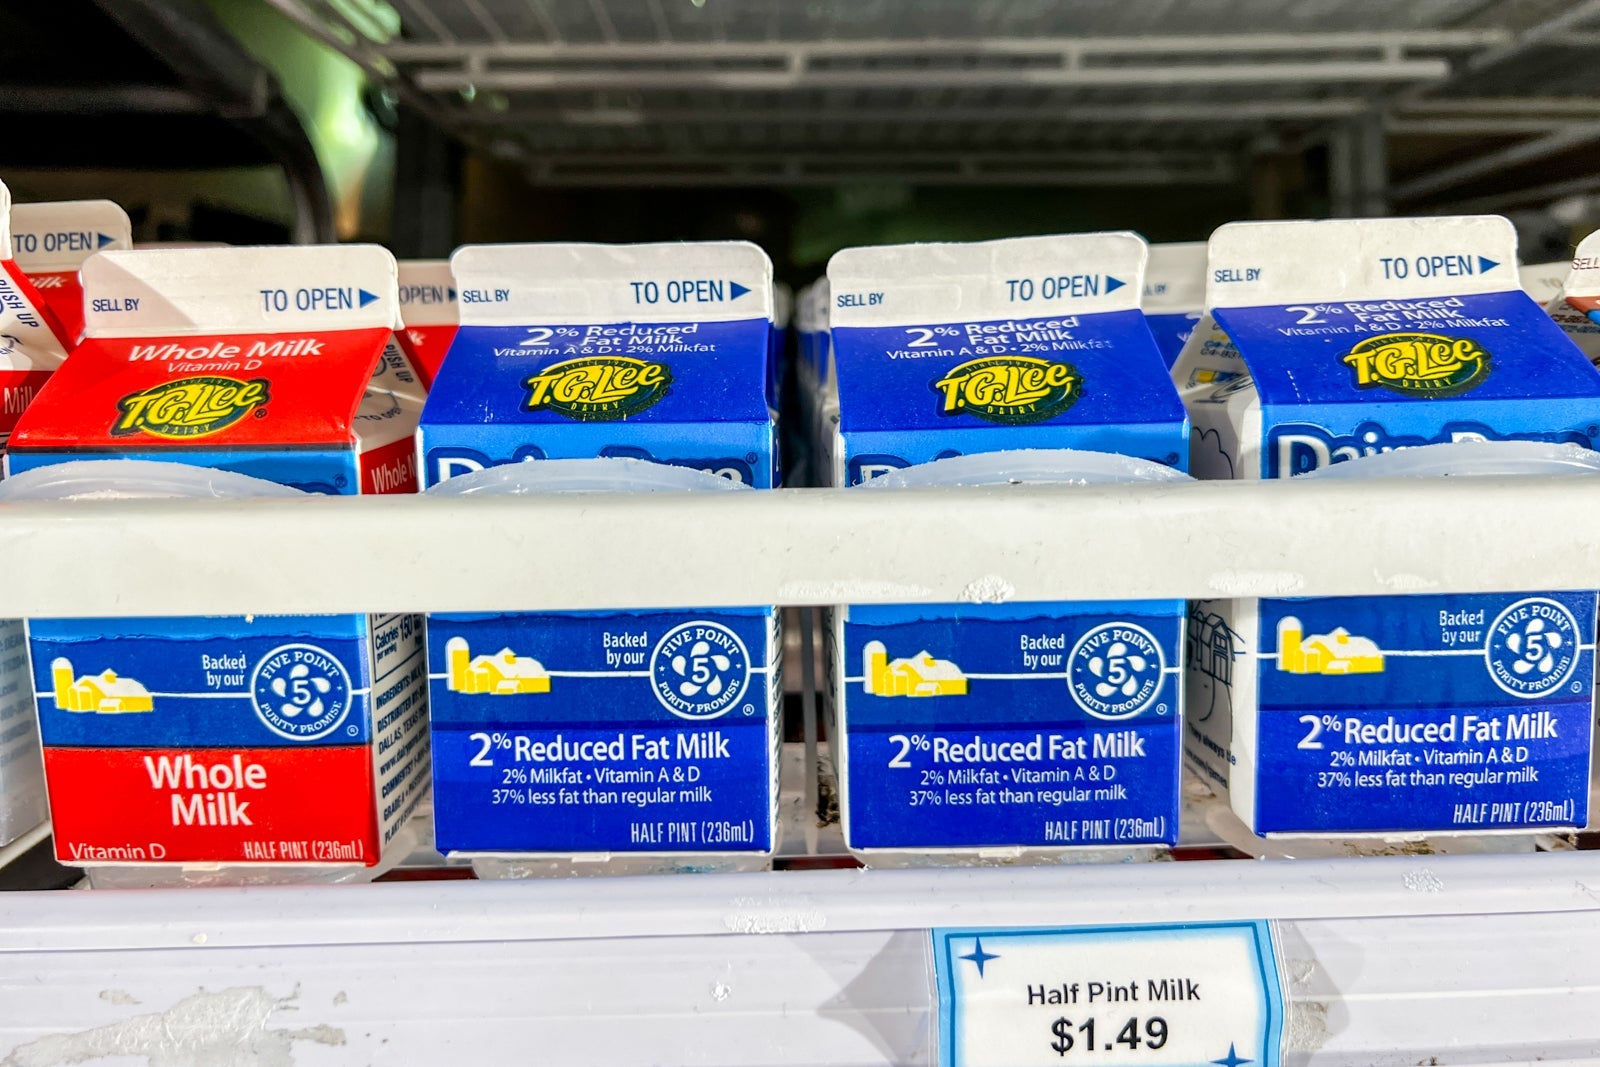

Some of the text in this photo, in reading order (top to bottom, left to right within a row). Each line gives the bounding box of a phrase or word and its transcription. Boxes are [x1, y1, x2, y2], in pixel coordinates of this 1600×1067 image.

[13, 232, 92, 252] TO OPEN
[1215, 268, 1260, 283] SELL BY
[1380, 255, 1472, 279] TO OPEN
[463, 290, 509, 302] SELL BY
[630, 280, 722, 304] TO OPEN
[1006, 275, 1098, 302] TO OPEN
[92, 299, 139, 312] SELL BY
[261, 288, 352, 312] TO OPEN
[837, 293, 884, 308] SELL BY
[16, 312, 39, 328] UP
[1286, 298, 1465, 325] 2% Reduced
[1354, 308, 1464, 323] Fat Milk
[520, 324, 698, 346] 2% Reduced
[905, 317, 1080, 348] 2% Reduced
[969, 330, 1074, 346] Fat Milk
[1278, 318, 1509, 337] Vitamin 2% Milkfat
[128, 339, 325, 361] Whole Milk
[494, 344, 715, 357] Vitamin 2% Milkfat
[583, 335, 683, 346] Fat Milk
[886, 348, 954, 360] Vitamin
[1022, 343, 1048, 352] 2%
[168, 360, 262, 372] Vitamin D
[396, 371, 414, 383] UP
[1403, 379, 1452, 388] DAIRY
[571, 402, 619, 412] DAIRY
[987, 404, 1036, 414] DAIRY
[162, 424, 210, 434] DAIRY
[371, 460, 408, 494] Whole
[1440, 610, 1484, 626] Backed
[1498, 606, 1572, 635] FIVE POINT
[603, 632, 648, 648] Backed
[662, 628, 740, 658] FIVE POINT
[1020, 634, 1065, 650] Backed
[1079, 630, 1155, 658] FIVE POINT
[1442, 628, 1481, 646] by our
[1525, 634, 1542, 661] 5
[202, 654, 246, 670] Backed
[260, 651, 340, 680] FIVE POINT
[606, 649, 645, 668] by our
[1024, 652, 1062, 670] by our
[207, 671, 244, 689] by our
[692, 657, 710, 684] 5
[1108, 658, 1126, 684] 5
[1493, 656, 1571, 690] PURITY PROMISE
[292, 680, 311, 704] 5
[659, 678, 740, 714] PURITY PROMISE
[1076, 679, 1155, 714] PURITY PROMISE
[260, 700, 342, 734] PURITY PROMISE
[1298, 712, 1558, 750] 2% Reduced Fat Milk
[469, 731, 730, 767] 2% Reduced Fat Milk
[888, 730, 1146, 768] 2% Reduced Fat Milk
[1330, 749, 1482, 768] 2% Milkfat Vitamin
[144, 754, 267, 790] Whole
[502, 766, 654, 784] 2% Milkfat Vitamin
[920, 767, 1070, 786] 2% Milkfat Vitamin
[1318, 767, 1538, 788] 37% less fat than regular milk
[492, 786, 712, 807] 37% less fat than regular milk
[910, 785, 1126, 807] 37% less fat than regular milk
[171, 793, 254, 826] Milk
[1453, 799, 1575, 824] HALF PINT (236mL)
[631, 820, 754, 844] HALF PINT (236mL)
[1045, 817, 1164, 840] HALF PINT (236mL)
[69, 842, 166, 860] Vitamin D
[244, 840, 364, 860] HALF PINT (236mL)
[1027, 978, 1200, 1006] Half Pint Milk
[1050, 1016, 1168, 1056] $1.49
